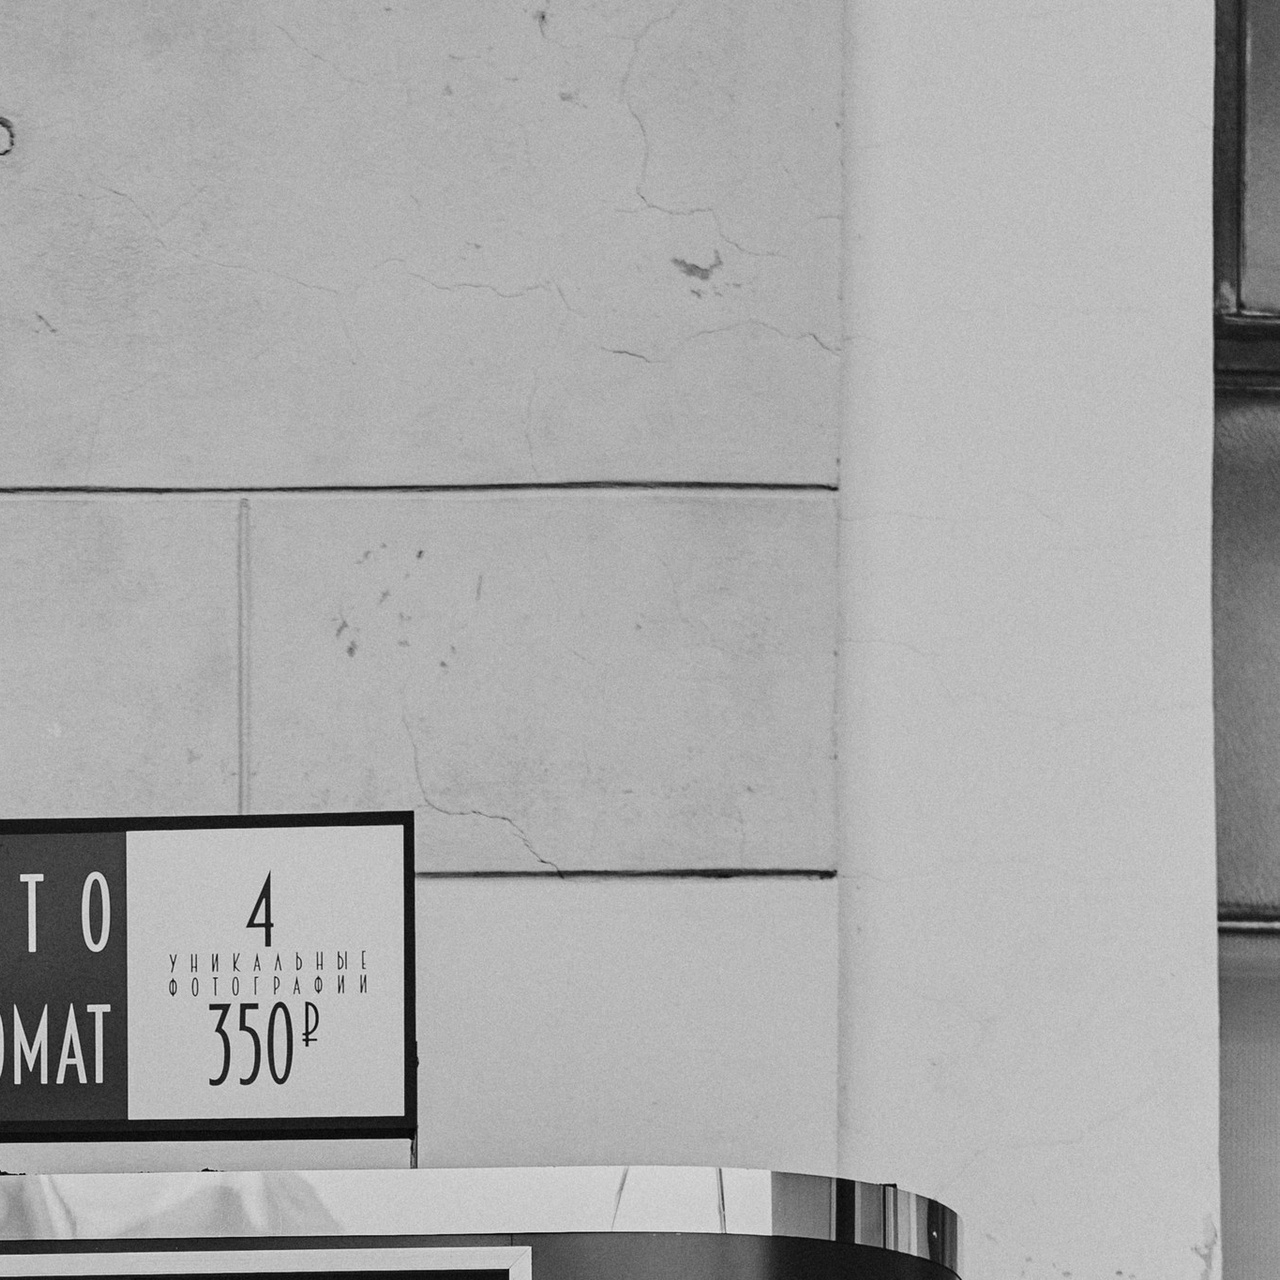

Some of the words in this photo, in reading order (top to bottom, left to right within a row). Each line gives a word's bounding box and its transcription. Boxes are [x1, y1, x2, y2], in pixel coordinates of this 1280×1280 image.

[245, 870, 274, 947] 4
[168, 950, 367, 973] УНИКАЛЬНЫЕ
[168, 974, 369, 997] ФОТОГРАФИИ
